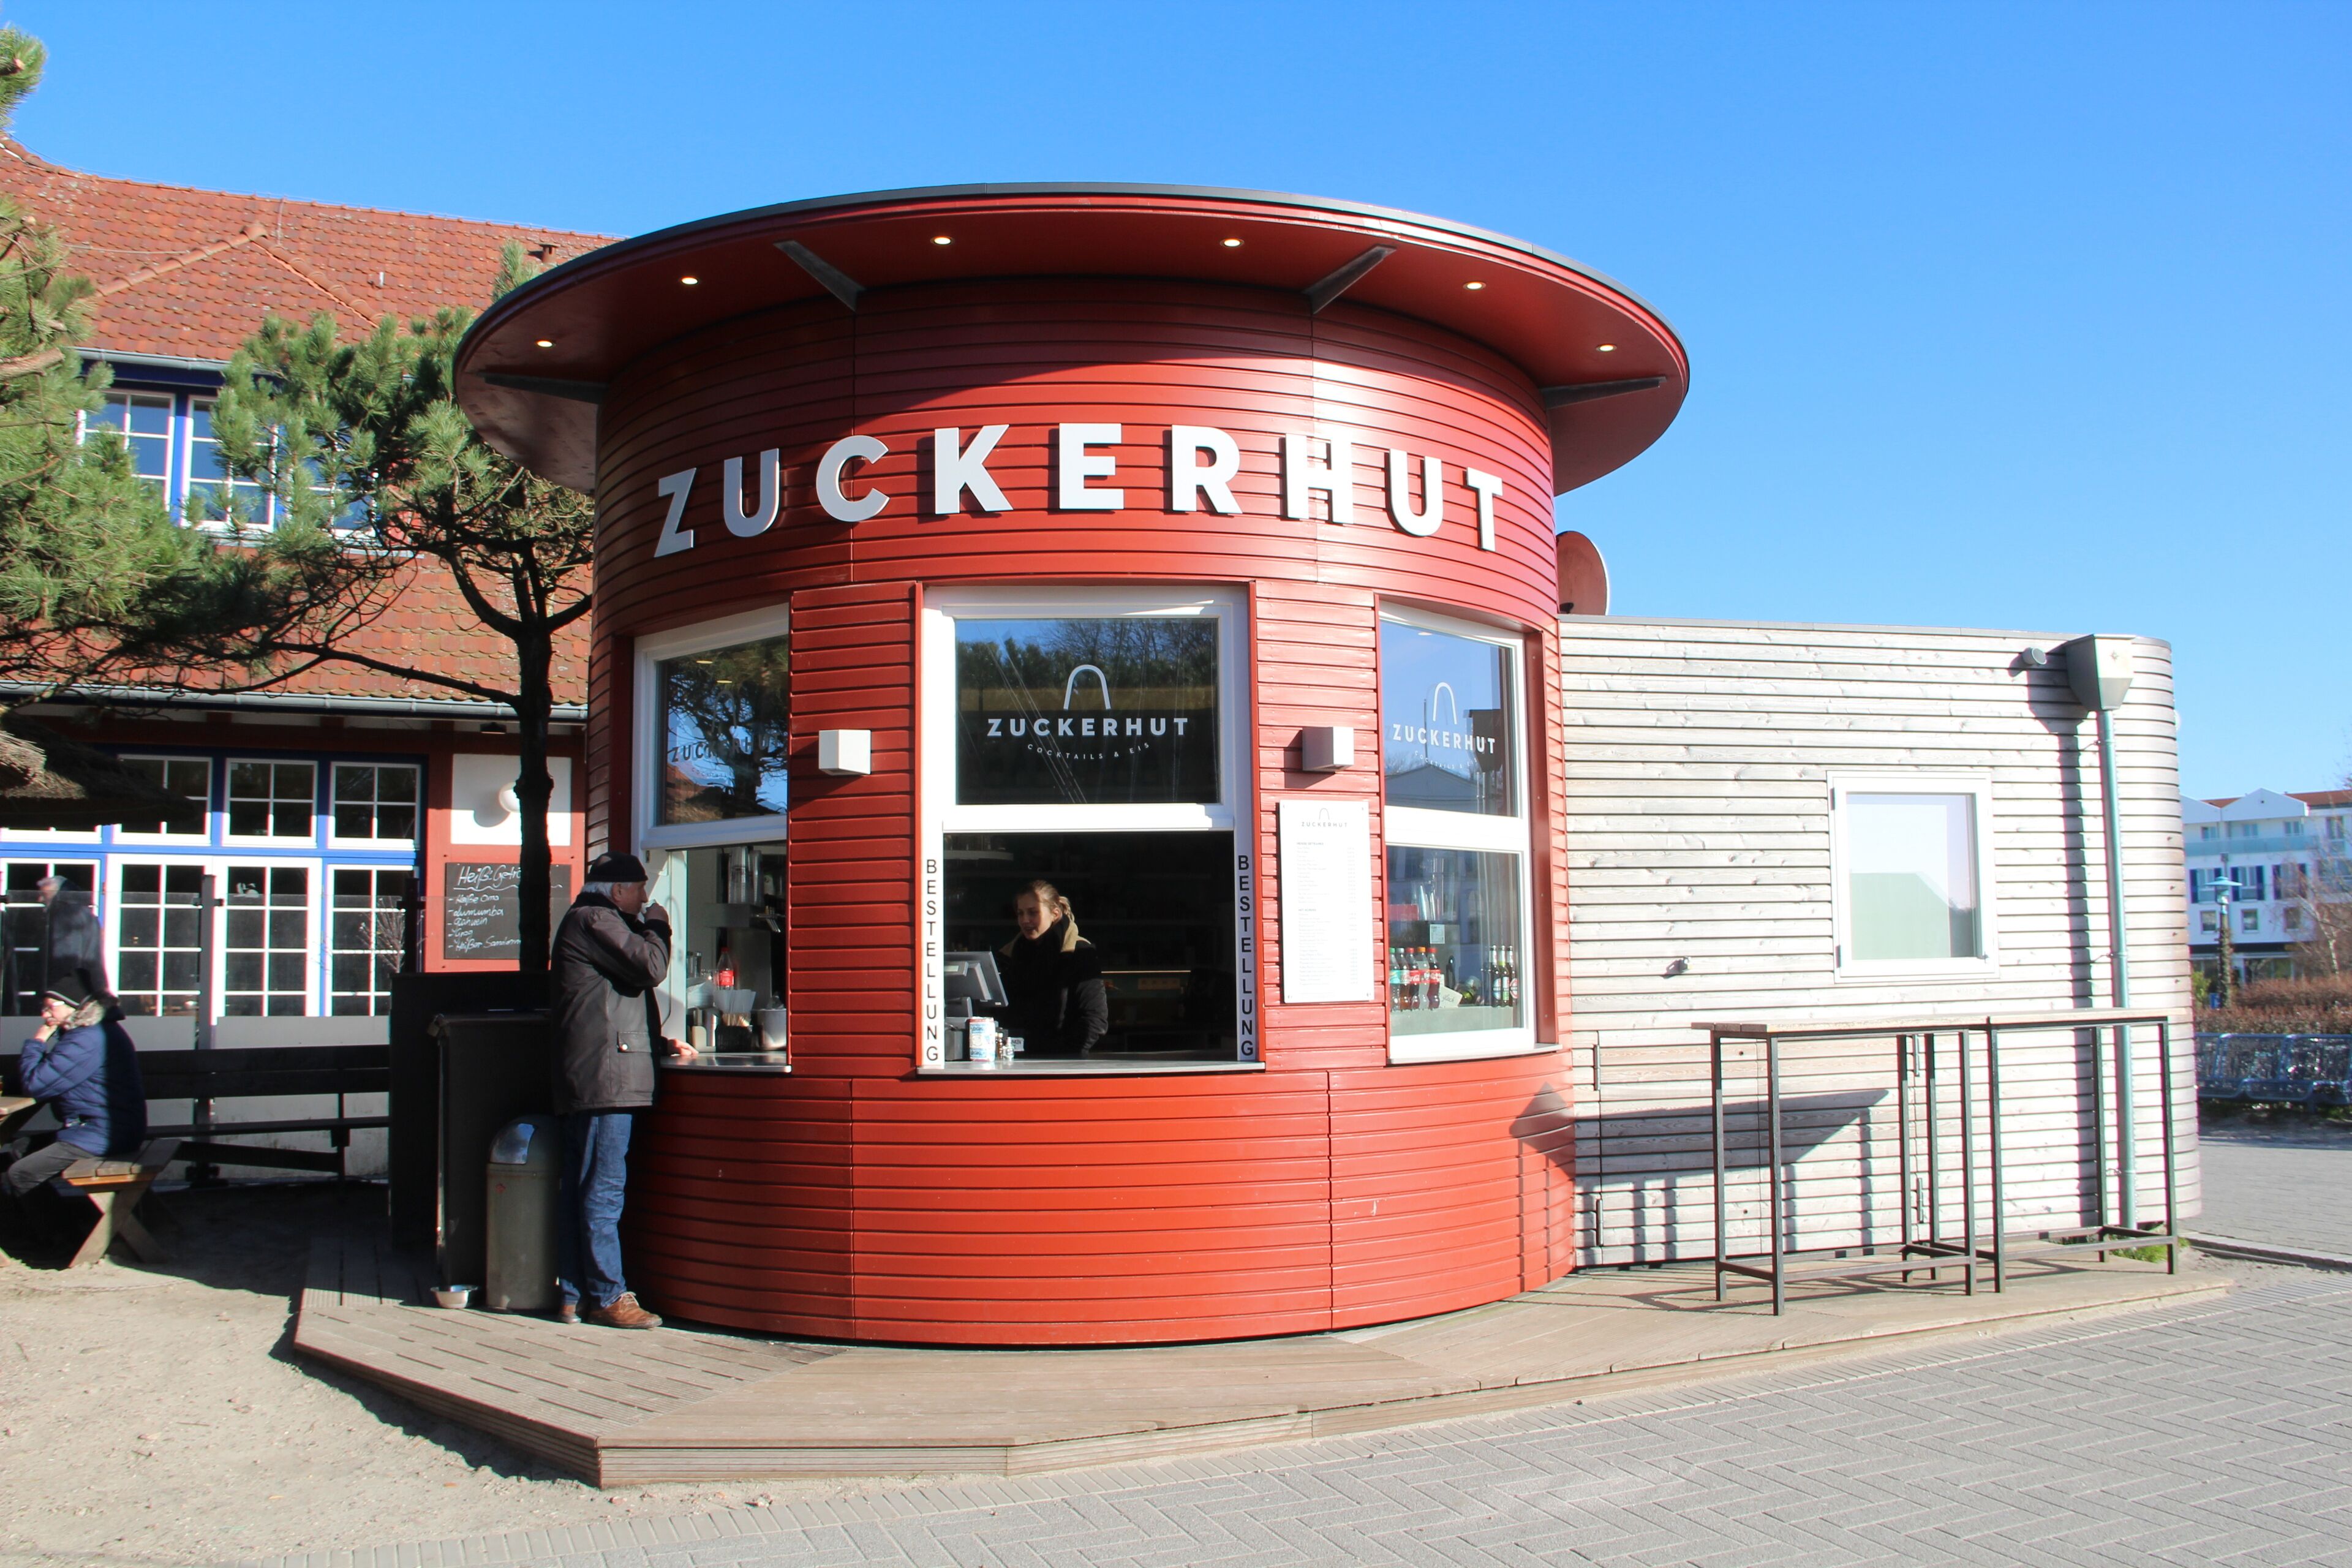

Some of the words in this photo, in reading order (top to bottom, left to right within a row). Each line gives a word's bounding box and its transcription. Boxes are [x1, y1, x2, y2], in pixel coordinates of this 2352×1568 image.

[654, 423, 1502, 558] ZUCKERHUT
[987, 717, 1188, 736] ZUCKERHUT
[1027, 743, 1104, 760] COCKTAILS
[1129, 742, 1150, 755] EIS
[1393, 723, 1496, 754] ZUCKERHUT
[926, 859, 938, 1061] BESTELLUNG
[1238, 854, 1254, 1057] BESTELLUNG
